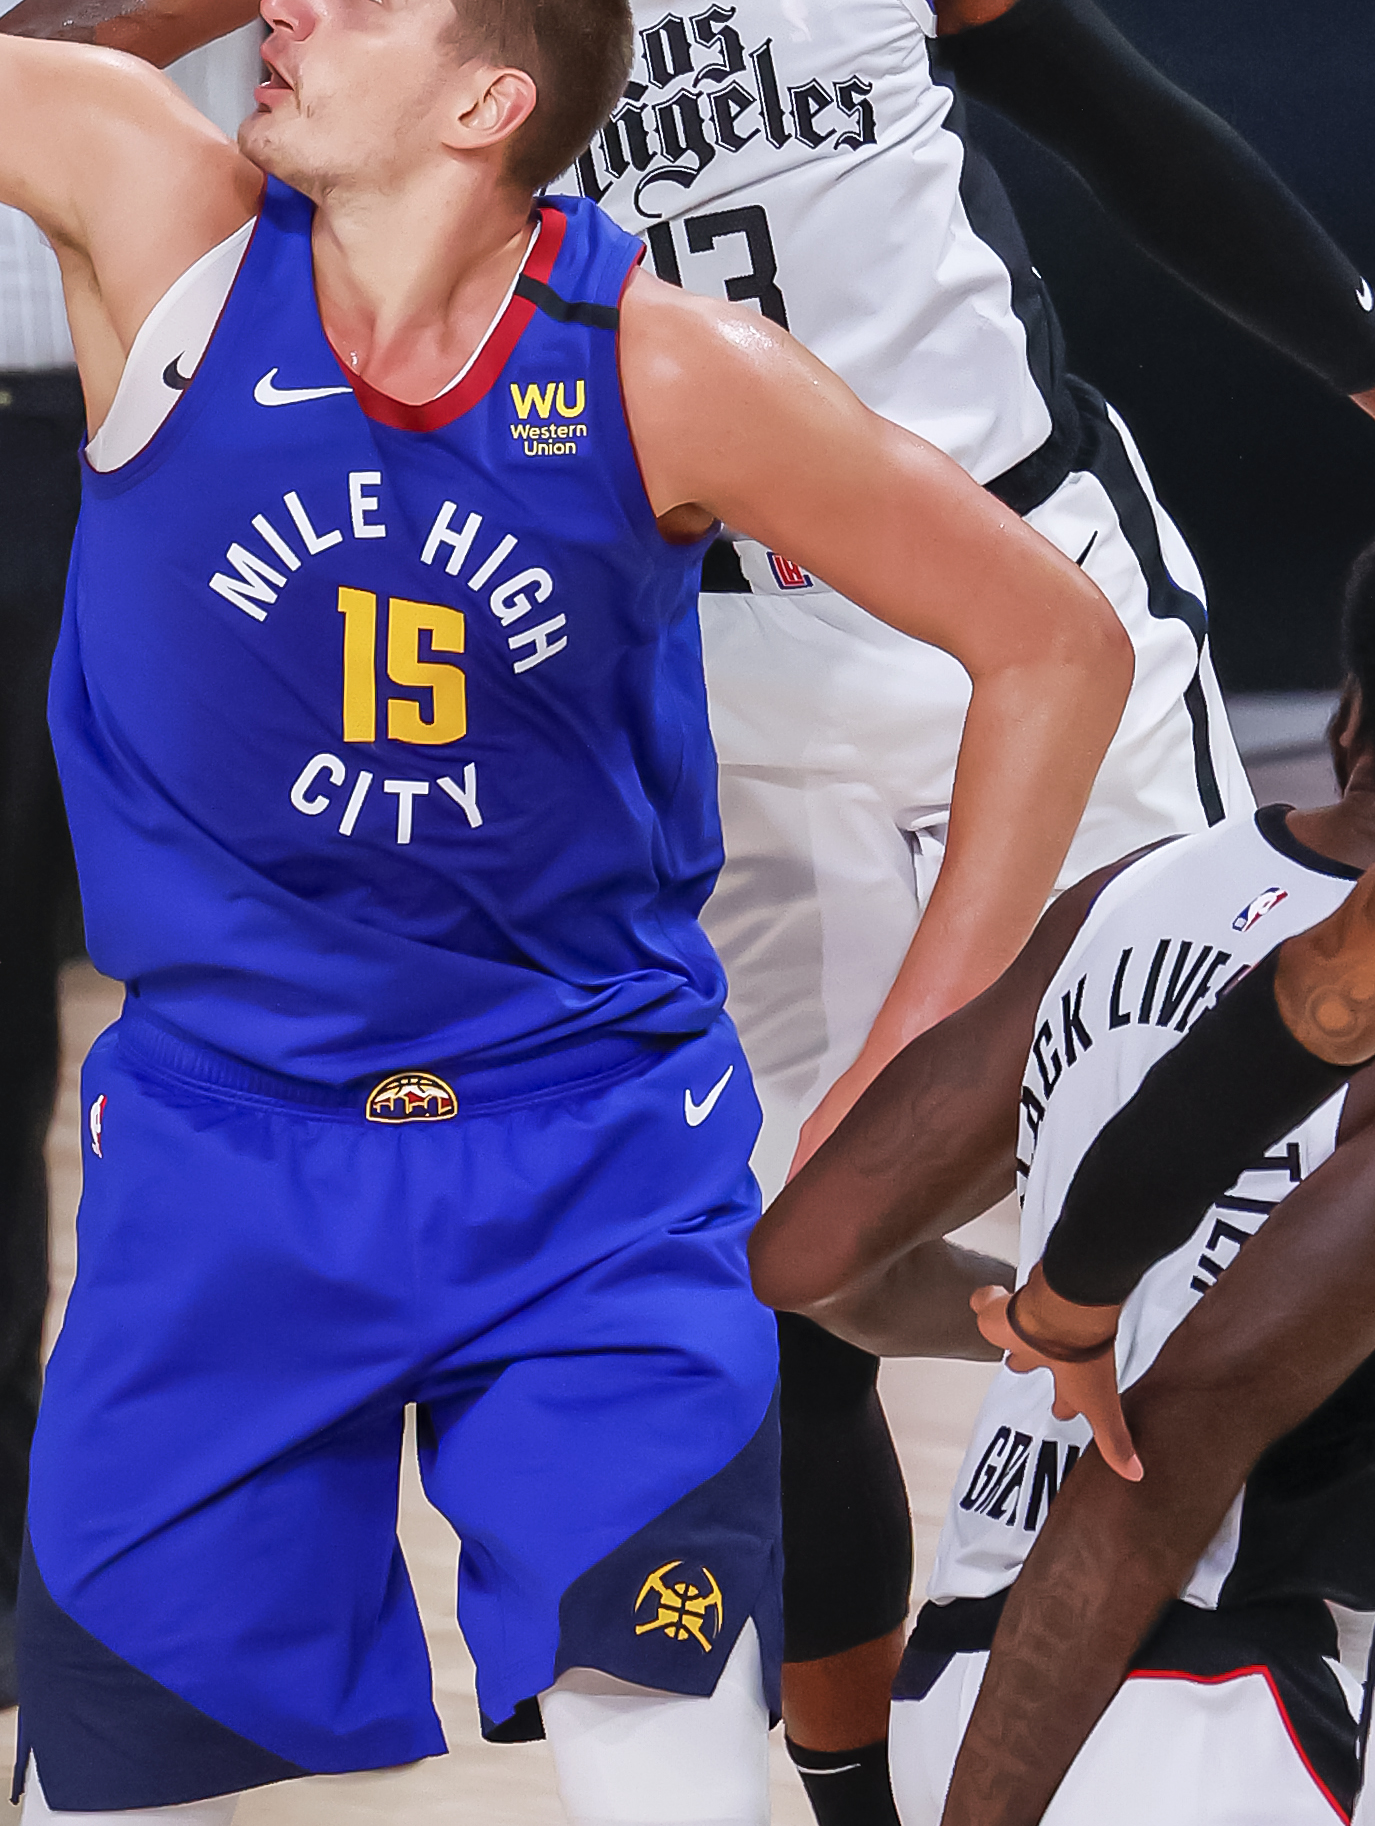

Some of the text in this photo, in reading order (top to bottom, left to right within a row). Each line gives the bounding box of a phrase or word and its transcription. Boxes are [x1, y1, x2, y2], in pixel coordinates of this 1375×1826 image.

[636, 3, 747, 90] os
[510, 380, 585, 420] WU
[510, 423, 587, 440] Western
[524, 438, 577, 456] Union
[208, 471, 568, 674] MILE HIGH
[337, 585, 468, 745] 15
[290, 752, 483, 845] CITY
[1016, 938, 1252, 1209] ACK LIVE
